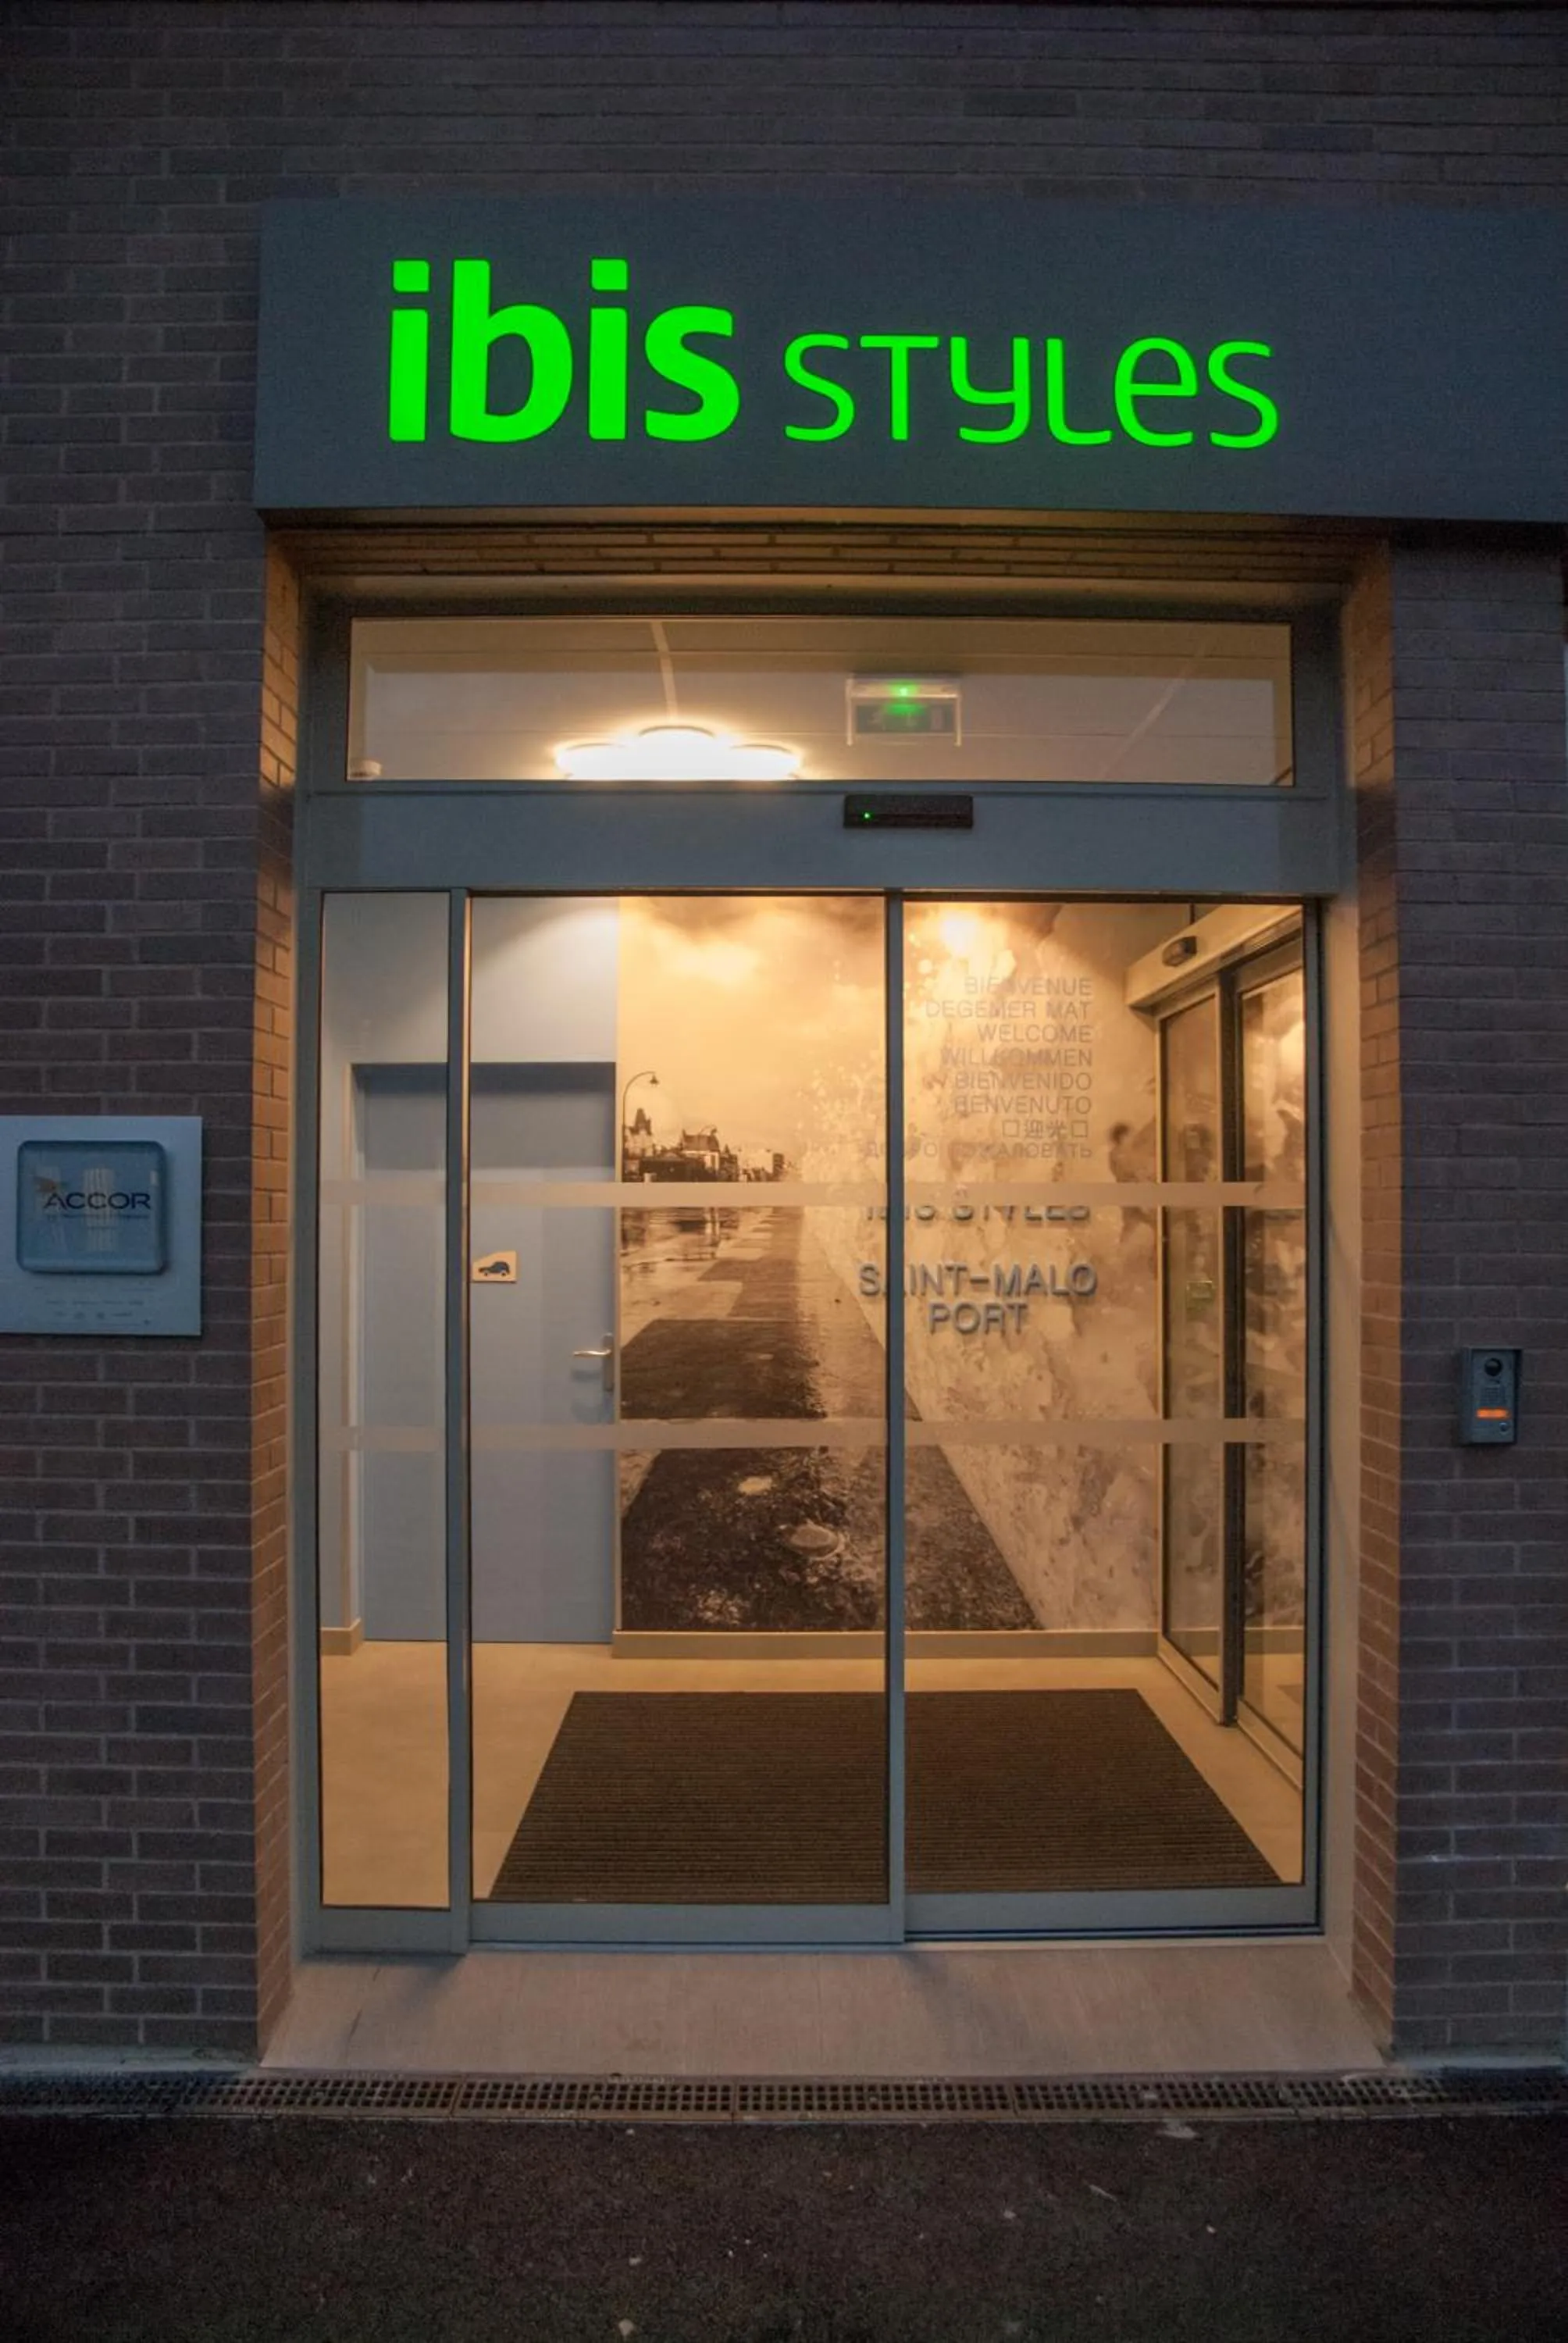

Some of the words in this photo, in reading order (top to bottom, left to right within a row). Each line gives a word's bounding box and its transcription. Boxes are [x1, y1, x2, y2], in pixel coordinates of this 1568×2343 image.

[389, 259, 739, 442] ibis
[964, 977, 1092, 996] BIEVENUE
[1046, 1000, 1092, 1019] MAT
[977, 1024, 1092, 1043] WELCOME
[940, 1048, 1092, 1067] WILLKOMMEN
[955, 1072, 1092, 1090] BIENVENIDO
[954, 1096, 1092, 1114] BENVENUTO
[949, 1142, 1092, 1159] АЛОВТЬ
[43, 1192, 151, 1210] ACCOR
[859, 1262, 1098, 1297] SINT-MALO
[928, 1303, 1028, 1336] PORT
